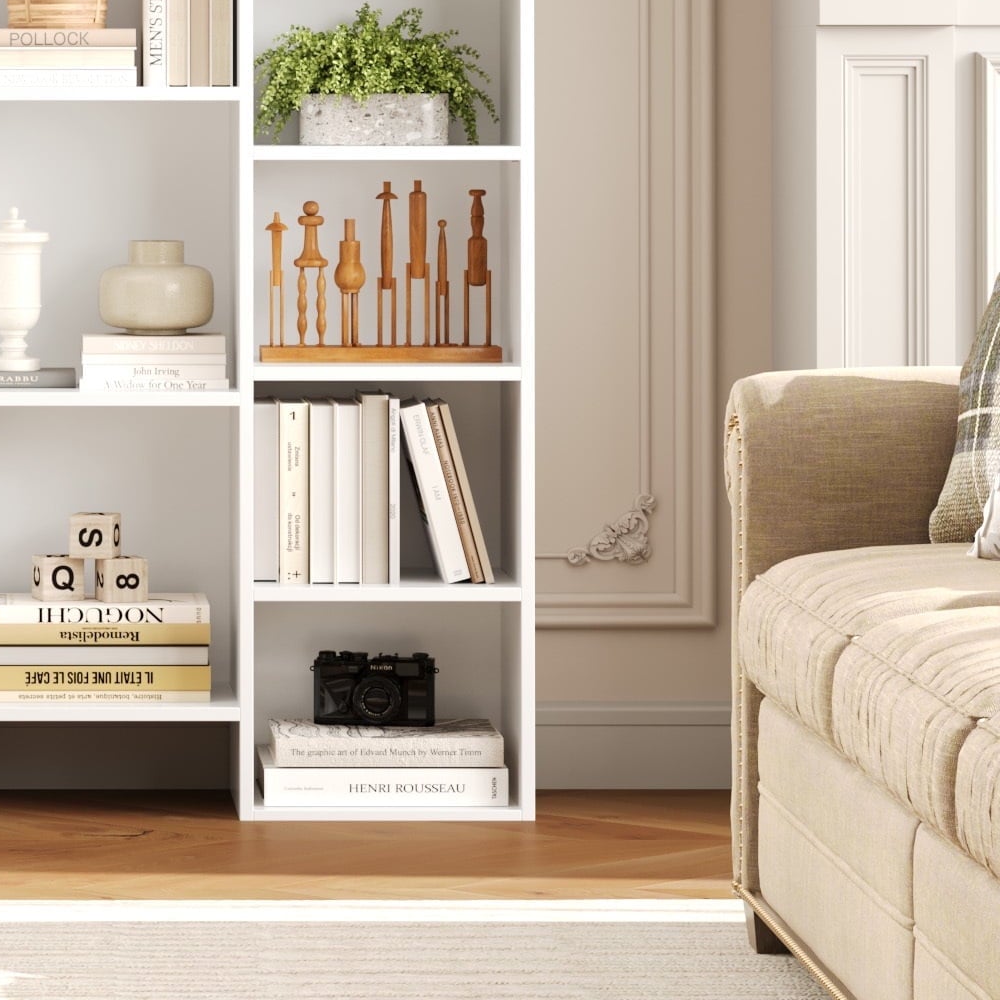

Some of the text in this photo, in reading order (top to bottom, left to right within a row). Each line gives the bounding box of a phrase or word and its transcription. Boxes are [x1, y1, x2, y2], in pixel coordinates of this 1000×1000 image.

[9, 32, 89, 46] POLLOCK
[149, 17, 163, 66] MEN'S
[133, 367, 180, 377] John Irving
[148, 380, 161, 389] for
[163, 380, 184, 389] One
[185, 380, 207, 390] Year
[78, 528, 103, 547] S
[51, 565, 75, 592] Q
[115, 573, 140, 590] 8
[38, 607, 164, 623] NOGUCHI
[59, 631, 140, 643] Remodelista
[25, 671, 154, 687] IL ÉTAIT UNE FOIS LE CAFÉ
[291, 748, 306, 756] The
[307, 748, 335, 758] graphic
[337, 748, 348, 756] art
[350, 748, 359, 756] of
[360, 748, 388, 756] Edvard
[389, 748, 416, 756] Munch
[418, 748, 428, 758] by
[430, 748, 457, 757] Werner
[349, 783, 466, 793] HENRI ROUSSEAU
